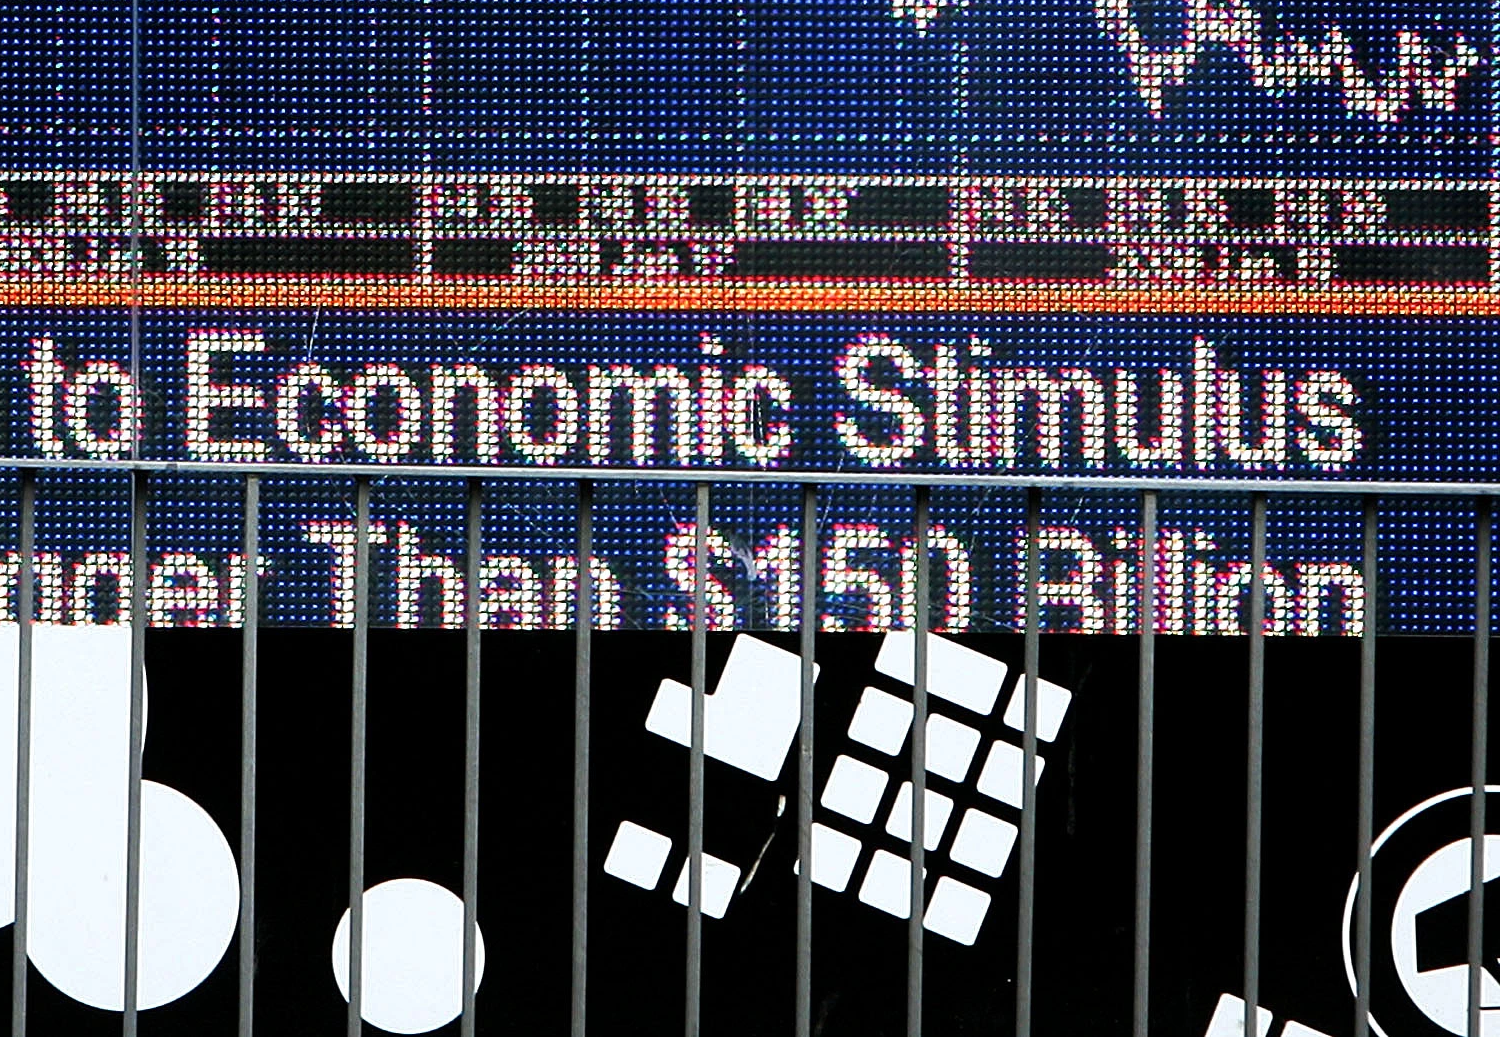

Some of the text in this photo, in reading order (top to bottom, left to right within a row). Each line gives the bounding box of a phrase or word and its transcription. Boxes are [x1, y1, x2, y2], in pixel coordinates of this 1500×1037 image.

[29, 331, 136, 457] to
[185, 329, 792, 463] Economic
[833, 332, 1364, 468] Stimulus
[304, 520, 621, 631] Than
[663, 523, 972, 634] $150
[1018, 526, 1368, 637] Billion
